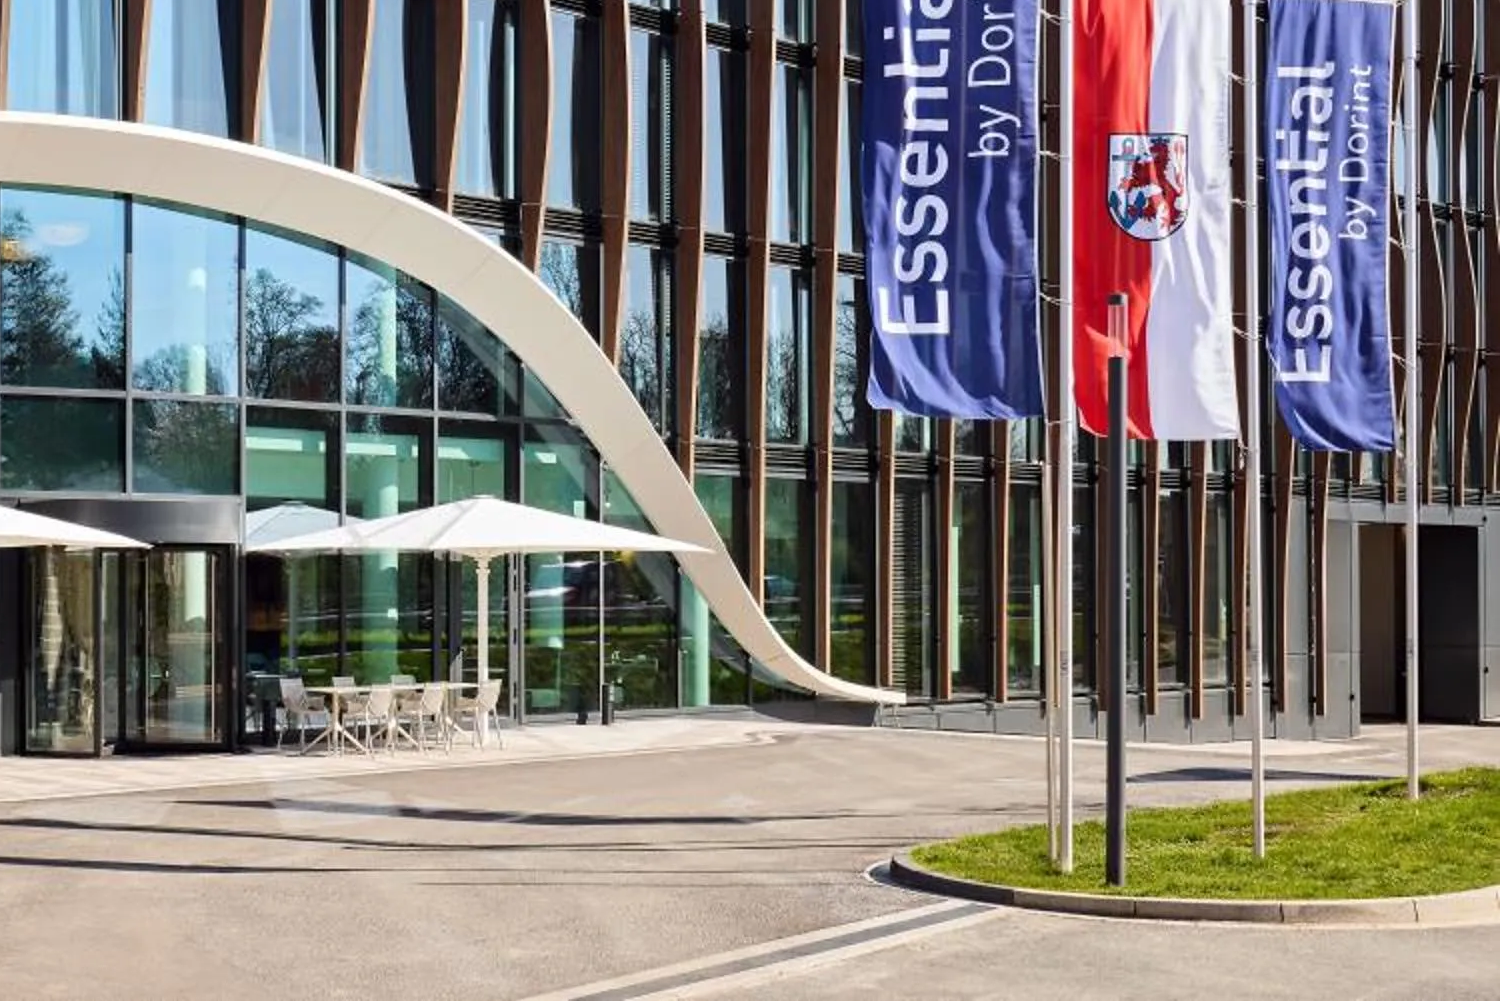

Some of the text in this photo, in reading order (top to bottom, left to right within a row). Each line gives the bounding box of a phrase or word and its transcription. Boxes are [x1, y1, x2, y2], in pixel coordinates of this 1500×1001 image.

[968, 104, 1022, 158] by
[1338, 64, 1377, 241] by Dorint
[1276, 60, 1335, 383] Essential
